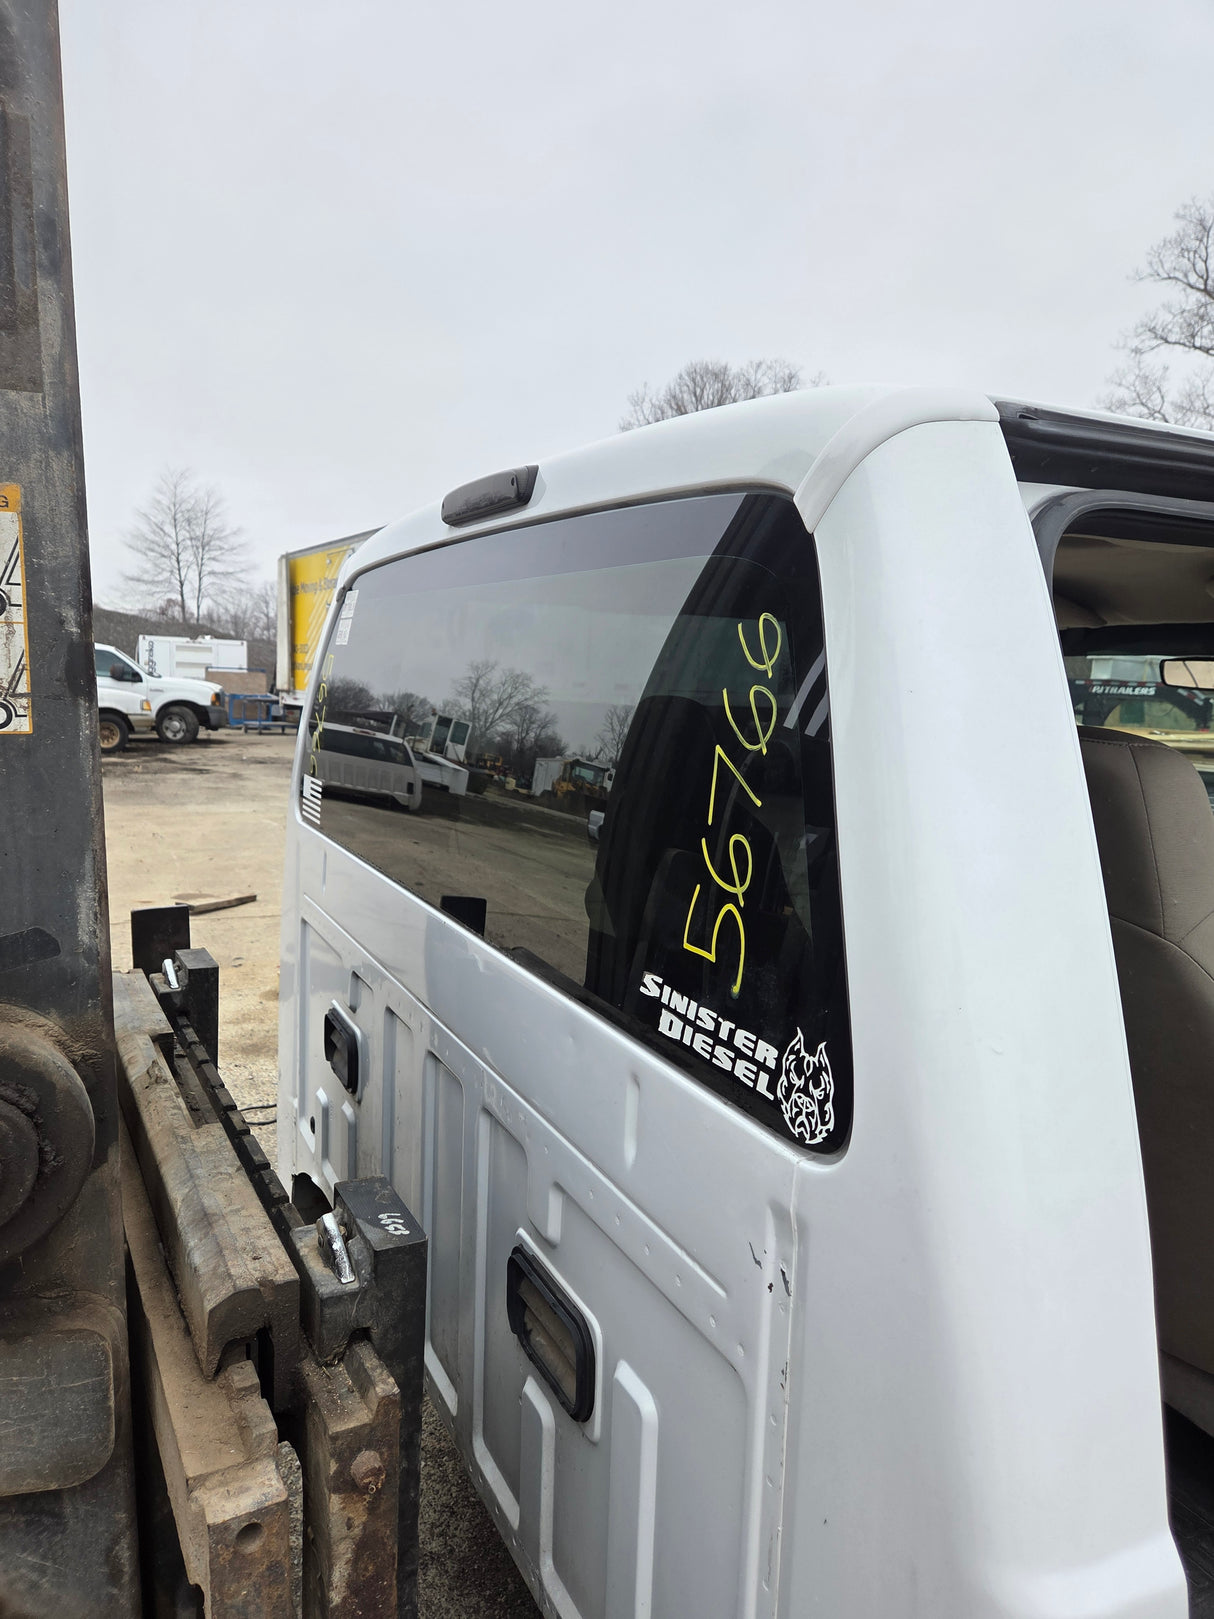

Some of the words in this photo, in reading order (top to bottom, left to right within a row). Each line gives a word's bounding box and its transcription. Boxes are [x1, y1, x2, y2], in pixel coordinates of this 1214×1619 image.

[1104, 686, 1157, 696] TRAILERS
[682, 612, 782, 993] 56766
[639, 972, 779, 1070] SINISTER
[657, 1007, 775, 1101] DIESEL
